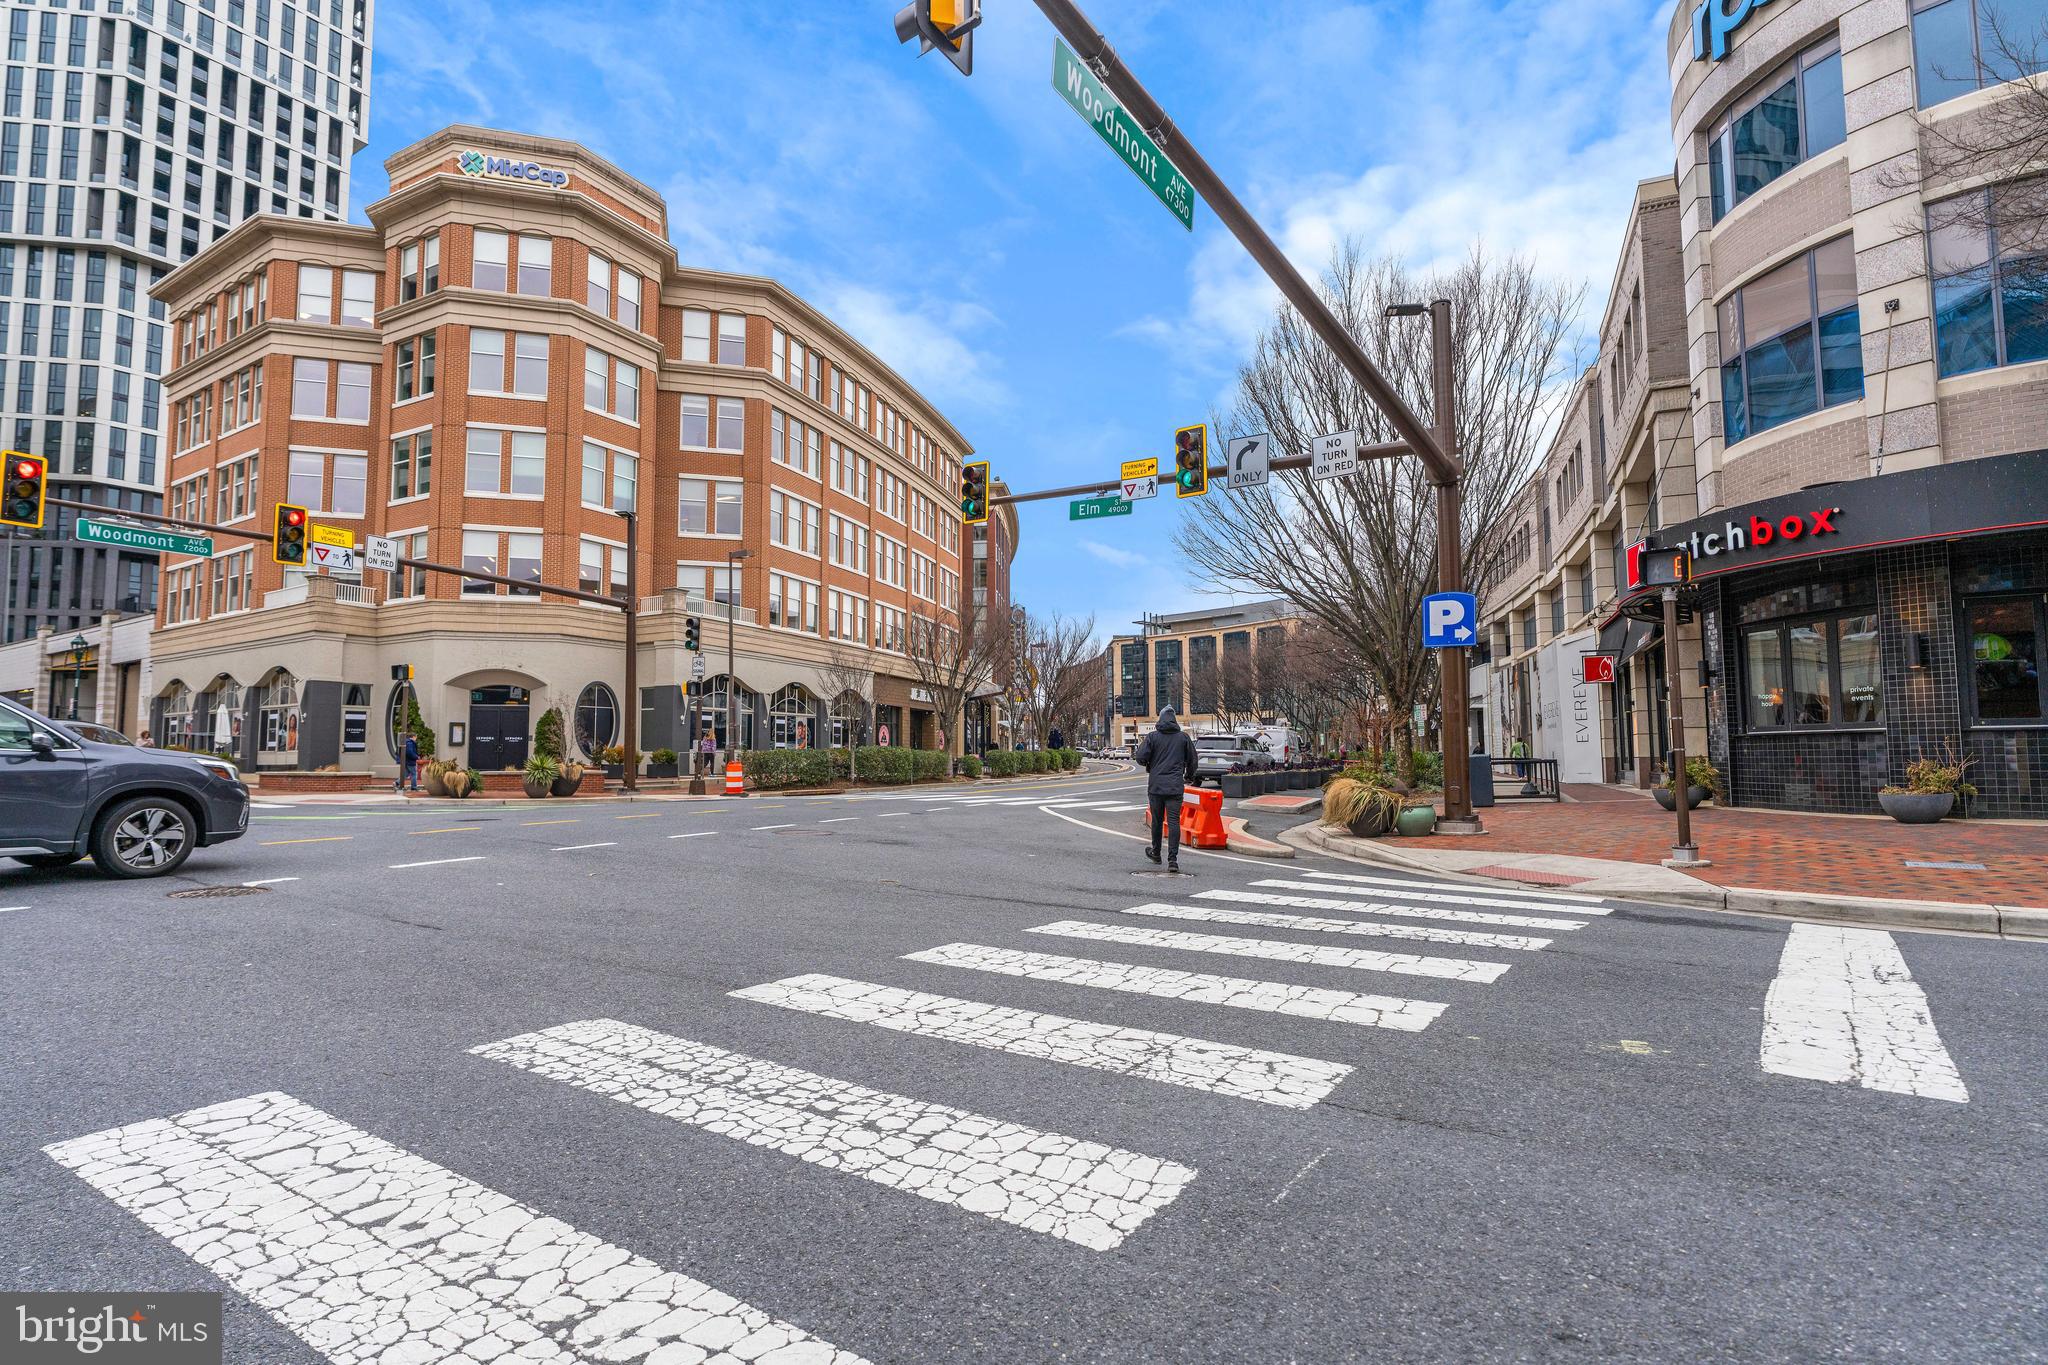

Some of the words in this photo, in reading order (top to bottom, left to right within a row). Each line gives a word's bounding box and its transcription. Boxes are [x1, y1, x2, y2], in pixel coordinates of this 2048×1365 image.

[1067, 60, 1159, 182] Woodmont
[486, 156, 567, 187] MidCap
[1170, 175, 1187, 200] AVE
[1168, 189, 1190, 219] 7300
[1326, 438, 1342, 449] NO
[1322, 449, 1348, 461] TURN
[1124, 462, 1146, 470] TURNING
[1317, 464, 1330, 475] ON
[1334, 460, 1354, 471] RED
[1123, 469, 1148, 477] VEHICLES
[1234, 470, 1262, 483] ONLY
[1079, 504, 1100, 516] Elm
[88, 524, 175, 548] Woodmont
[322, 529, 345, 538] TURNING
[188, 537, 205, 547] AVE
[320, 536, 346, 545] VEHICLES
[376, 541, 388, 549] NO
[184, 544, 204, 554] 7200
[373, 549, 391, 558] TURN
[368, 557, 378, 565] ON
[381, 559, 394, 568] RED
[1429, 600, 1465, 637] P
[1850, 685, 1874, 694] private
[1758, 693, 1777, 701] happy
[1572, 667, 1590, 743] EVEREVE
